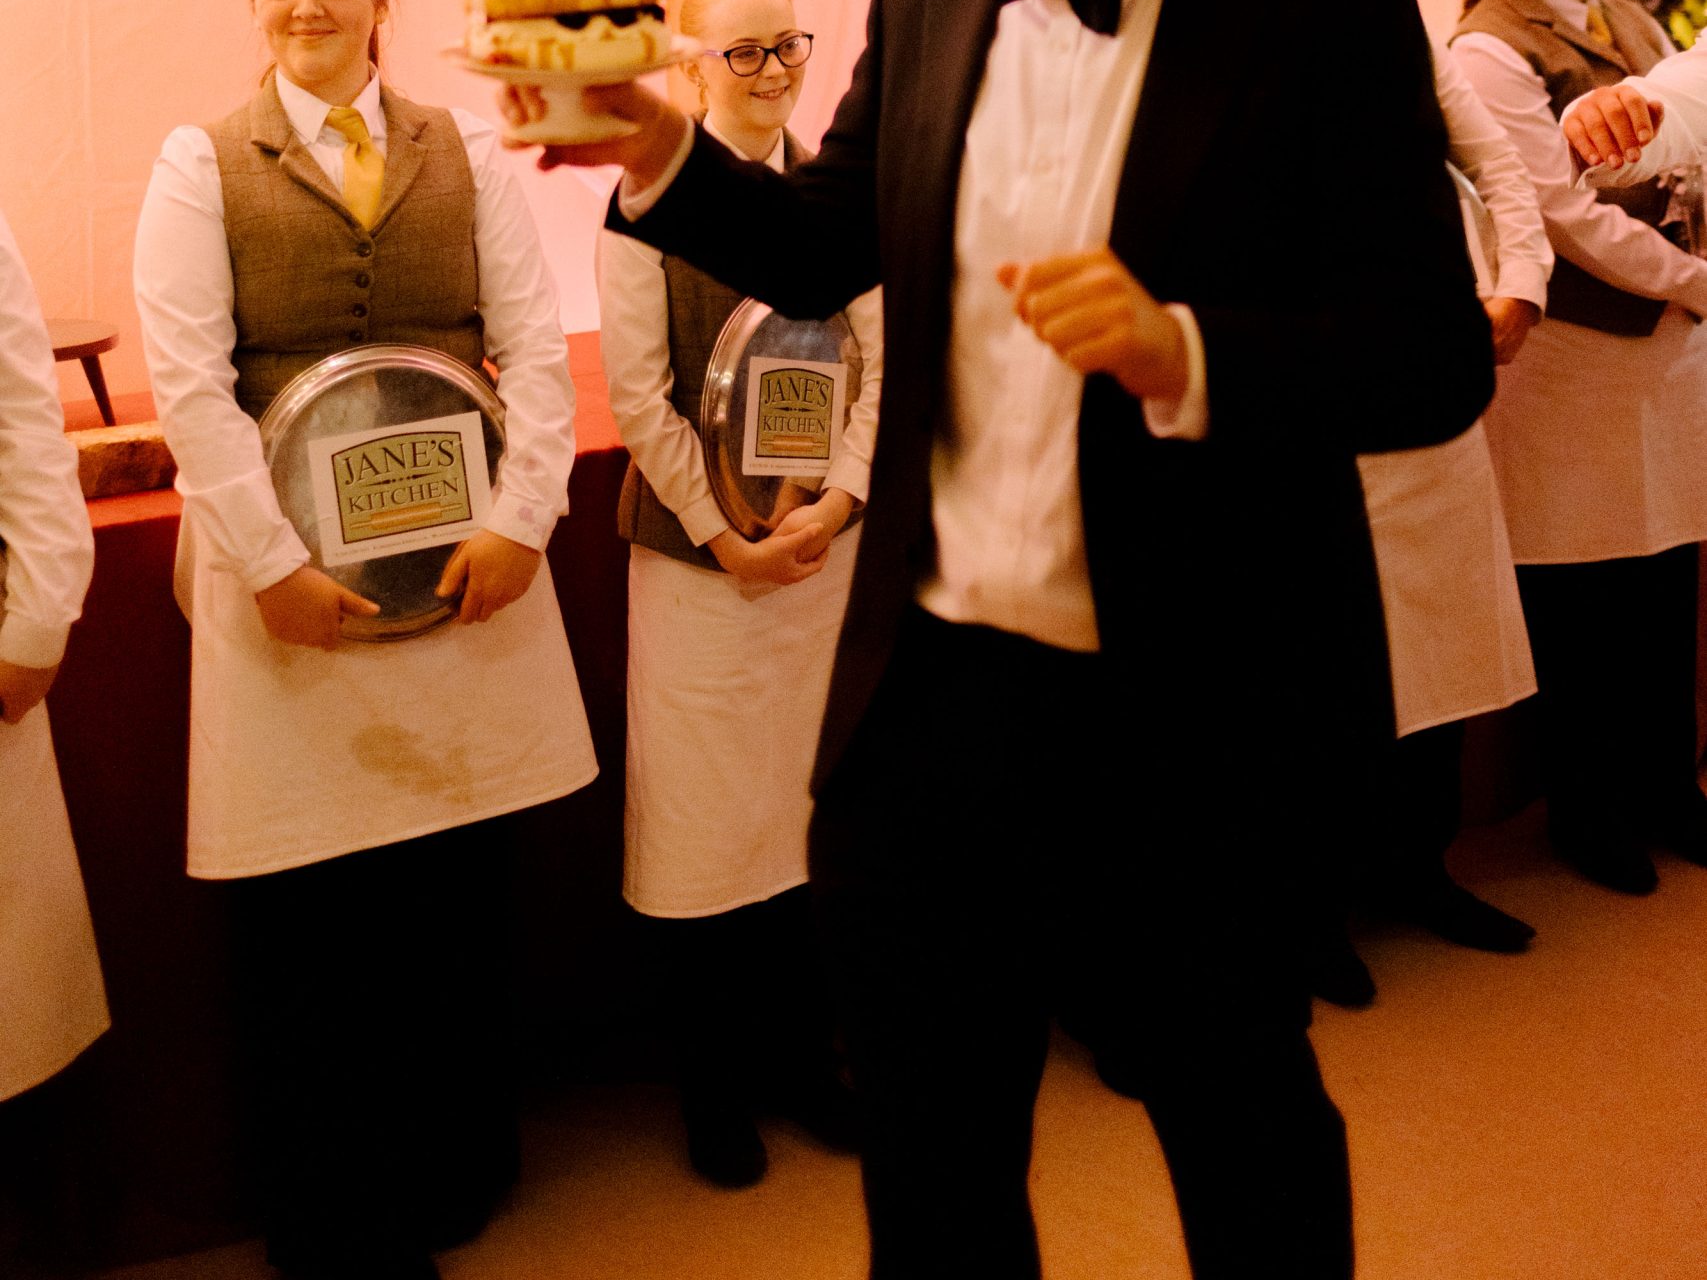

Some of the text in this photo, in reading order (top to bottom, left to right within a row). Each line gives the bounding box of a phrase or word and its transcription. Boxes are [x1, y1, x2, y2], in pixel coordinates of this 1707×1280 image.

[764, 377, 829, 407] JANE’S
[762, 415, 825, 433] KITCHEN
[344, 439, 455, 485] JANE’S
[349, 478, 459, 514] KITCHEN
